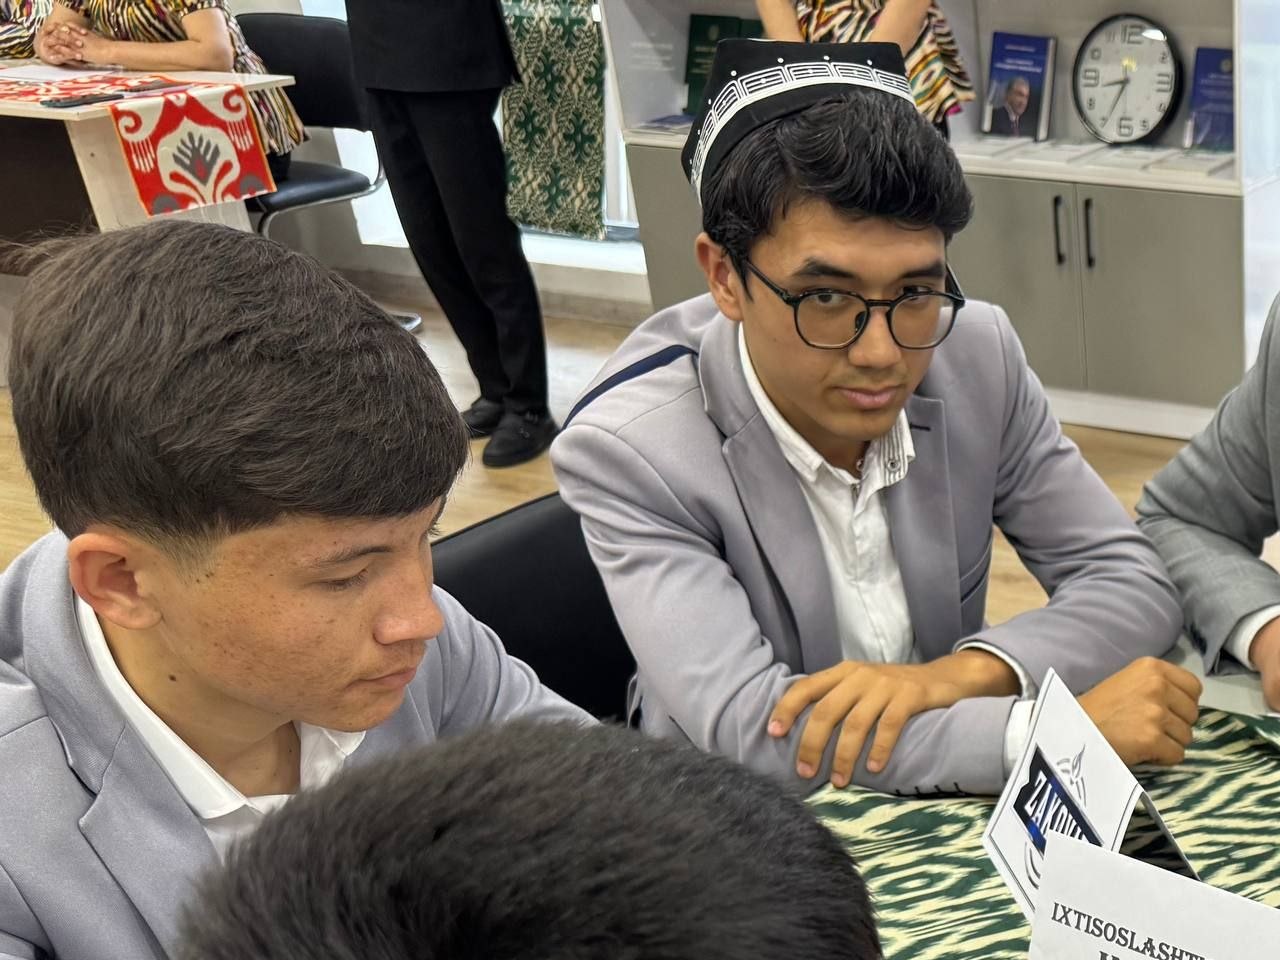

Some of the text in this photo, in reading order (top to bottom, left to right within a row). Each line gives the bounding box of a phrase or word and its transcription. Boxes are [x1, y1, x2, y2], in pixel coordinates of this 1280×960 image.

[1121, 24, 1146, 45] 12
[1081, 68, 1099, 88] 9
[1155, 73, 1173, 92] 3
[1117, 117, 1134, 137] 6
